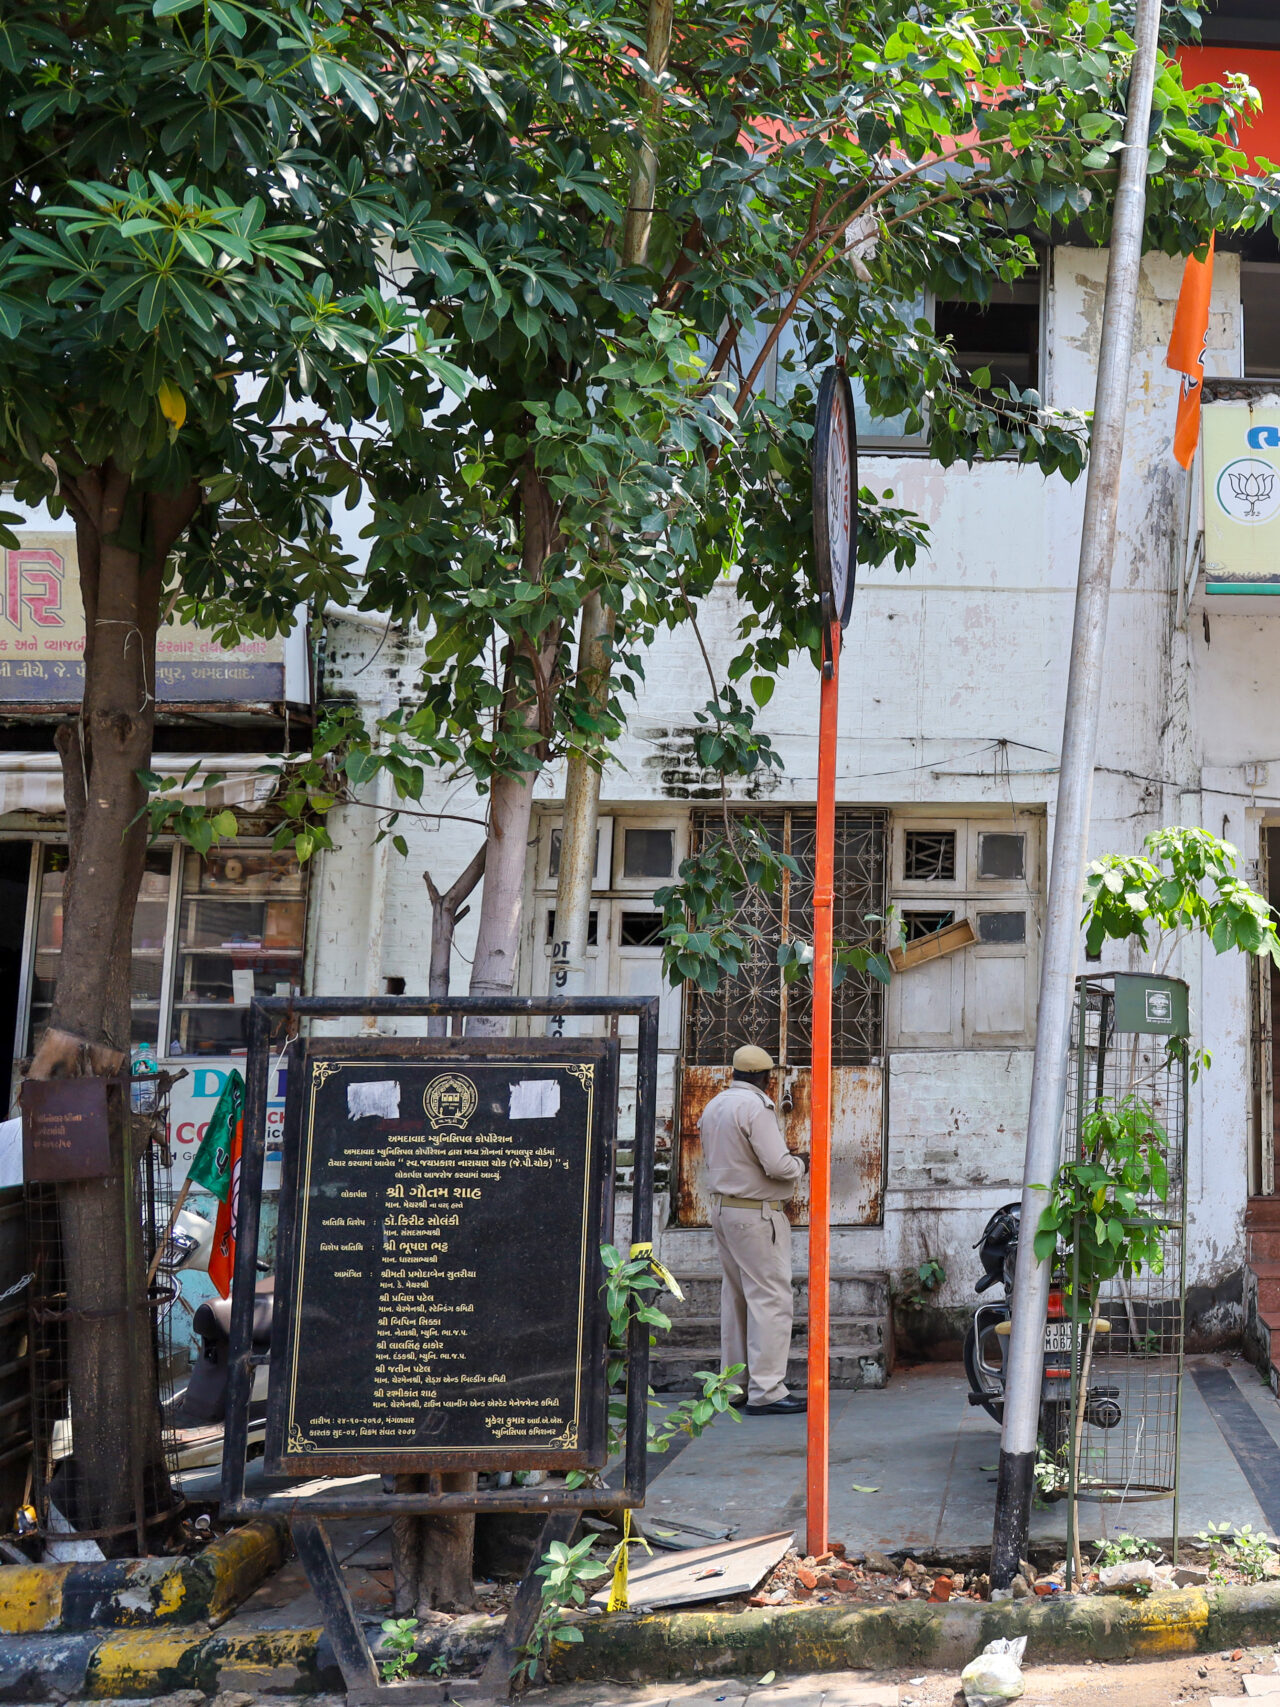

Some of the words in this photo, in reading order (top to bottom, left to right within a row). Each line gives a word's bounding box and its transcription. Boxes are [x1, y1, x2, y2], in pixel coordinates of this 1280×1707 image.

[15, 635, 38, 651] અને
[16, 662, 48, 680] નીચે,
[388, 1135, 426, 1143] અમદાવાદ
[386, 1184, 404, 1198] શ્રી
[409, 1183, 448, 1198] ગૌતમ
[453, 1187, 482, 1200] શાહ
[383, 1239, 396, 1252] શ્રી
